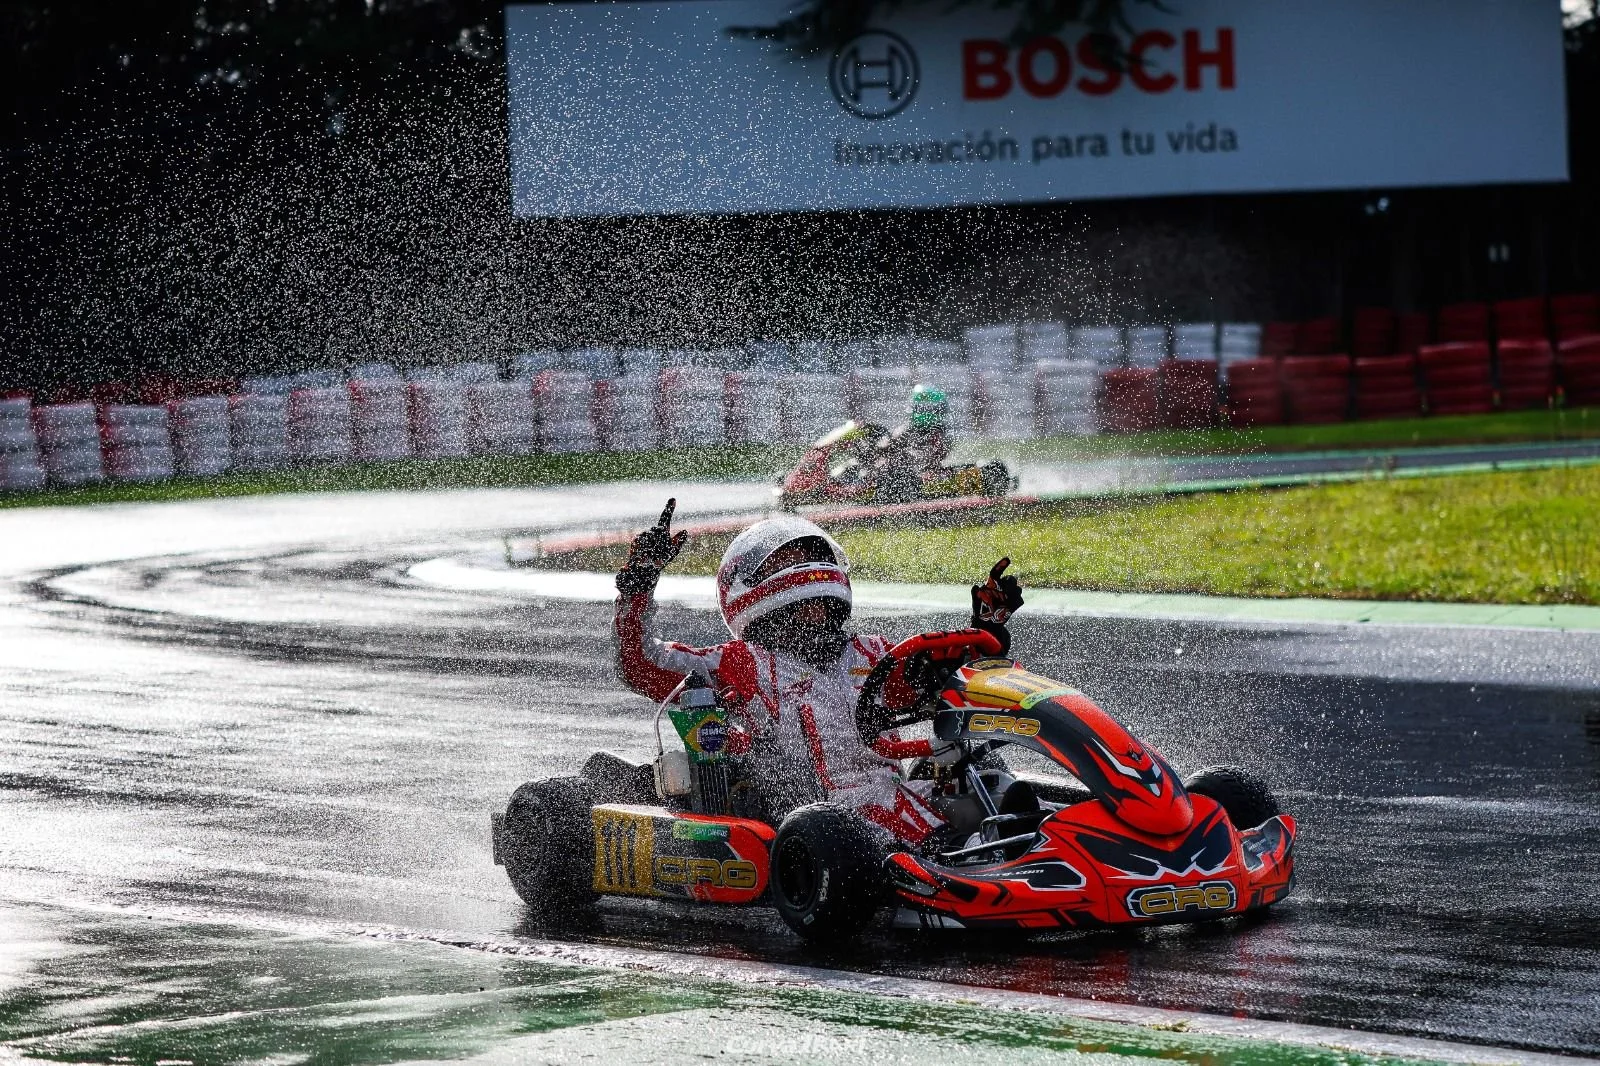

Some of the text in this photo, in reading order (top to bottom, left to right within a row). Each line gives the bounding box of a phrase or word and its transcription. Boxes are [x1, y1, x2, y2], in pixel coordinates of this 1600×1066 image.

[961, 27, 1236, 100] BOSCH
[834, 122, 1239, 167] Innovación para tu vida
[968, 713, 1041, 737] CRG
[655, 855, 757, 890] CRG
[1138, 886, 1231, 915] CRG
